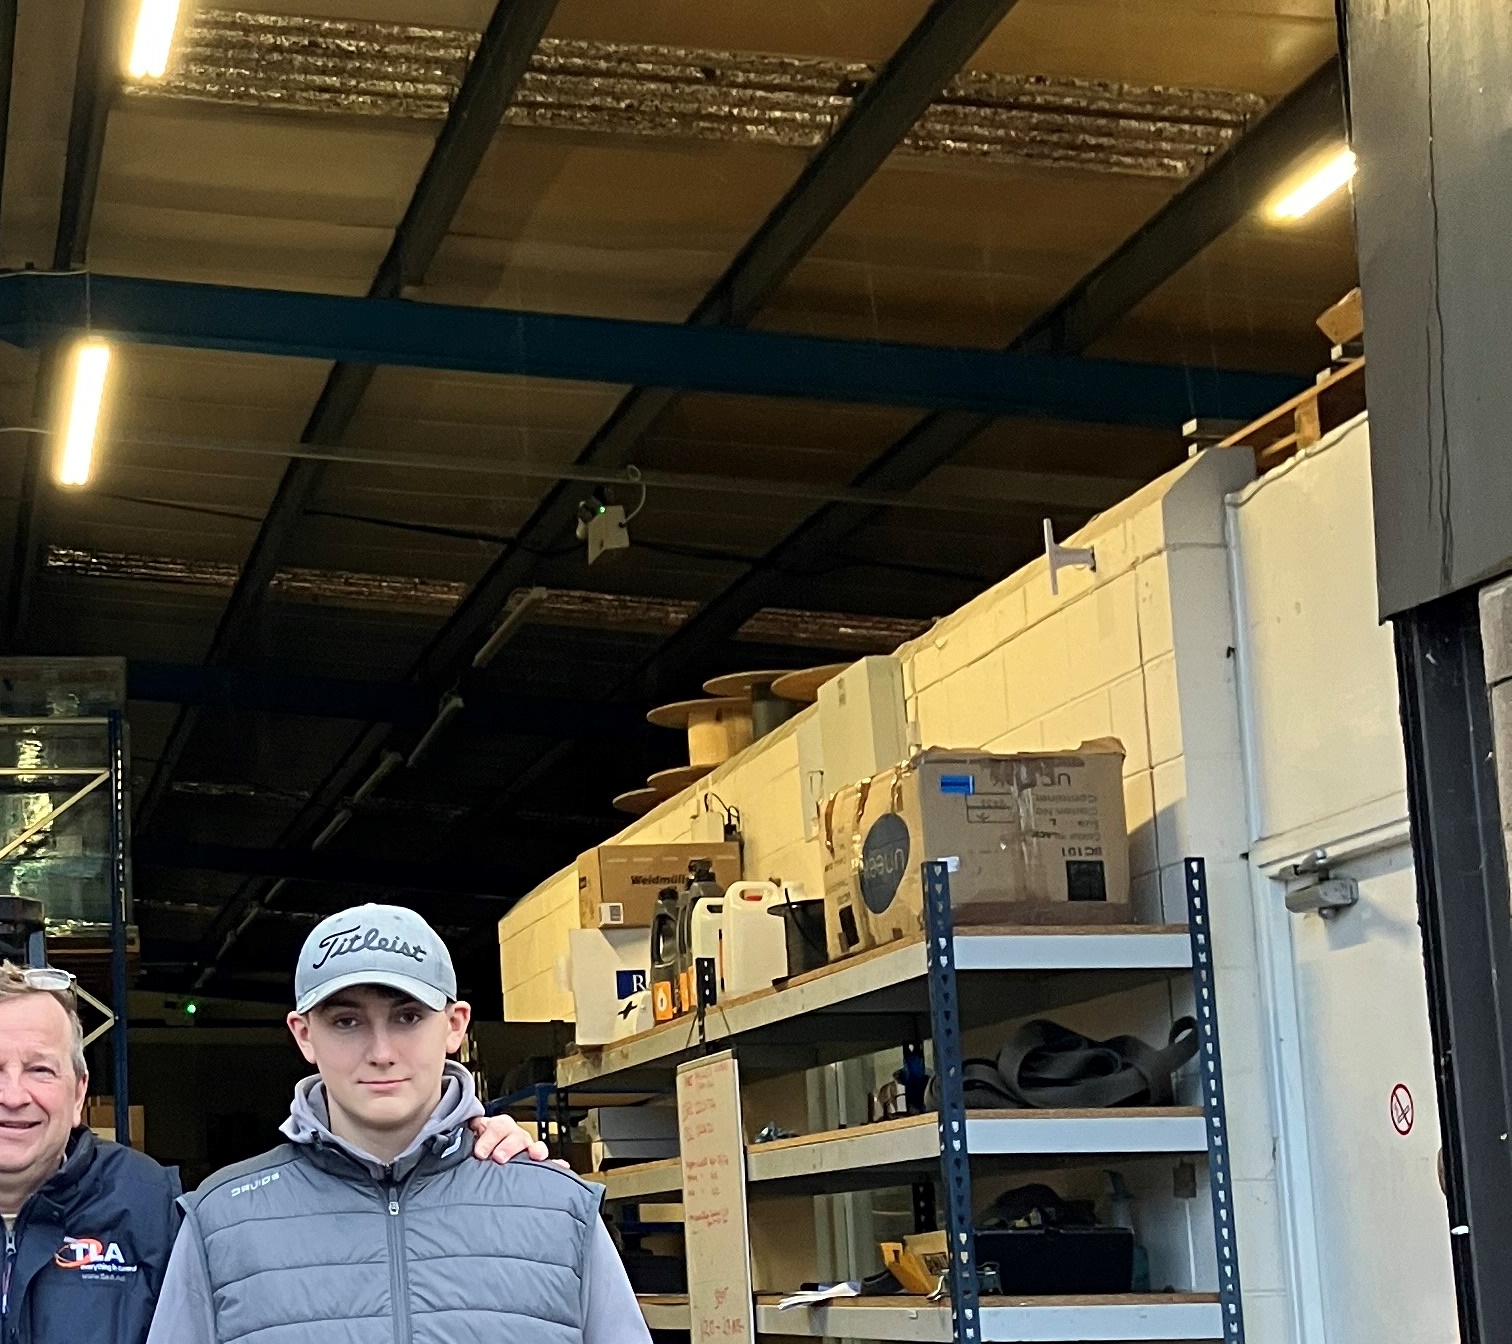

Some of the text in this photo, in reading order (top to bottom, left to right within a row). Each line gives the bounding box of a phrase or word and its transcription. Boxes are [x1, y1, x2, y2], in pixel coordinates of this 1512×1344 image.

[630, 875, 687, 885] Weidmüll
[312, 924, 428, 970] Titleist
[69, 1242, 126, 1264] TLA
